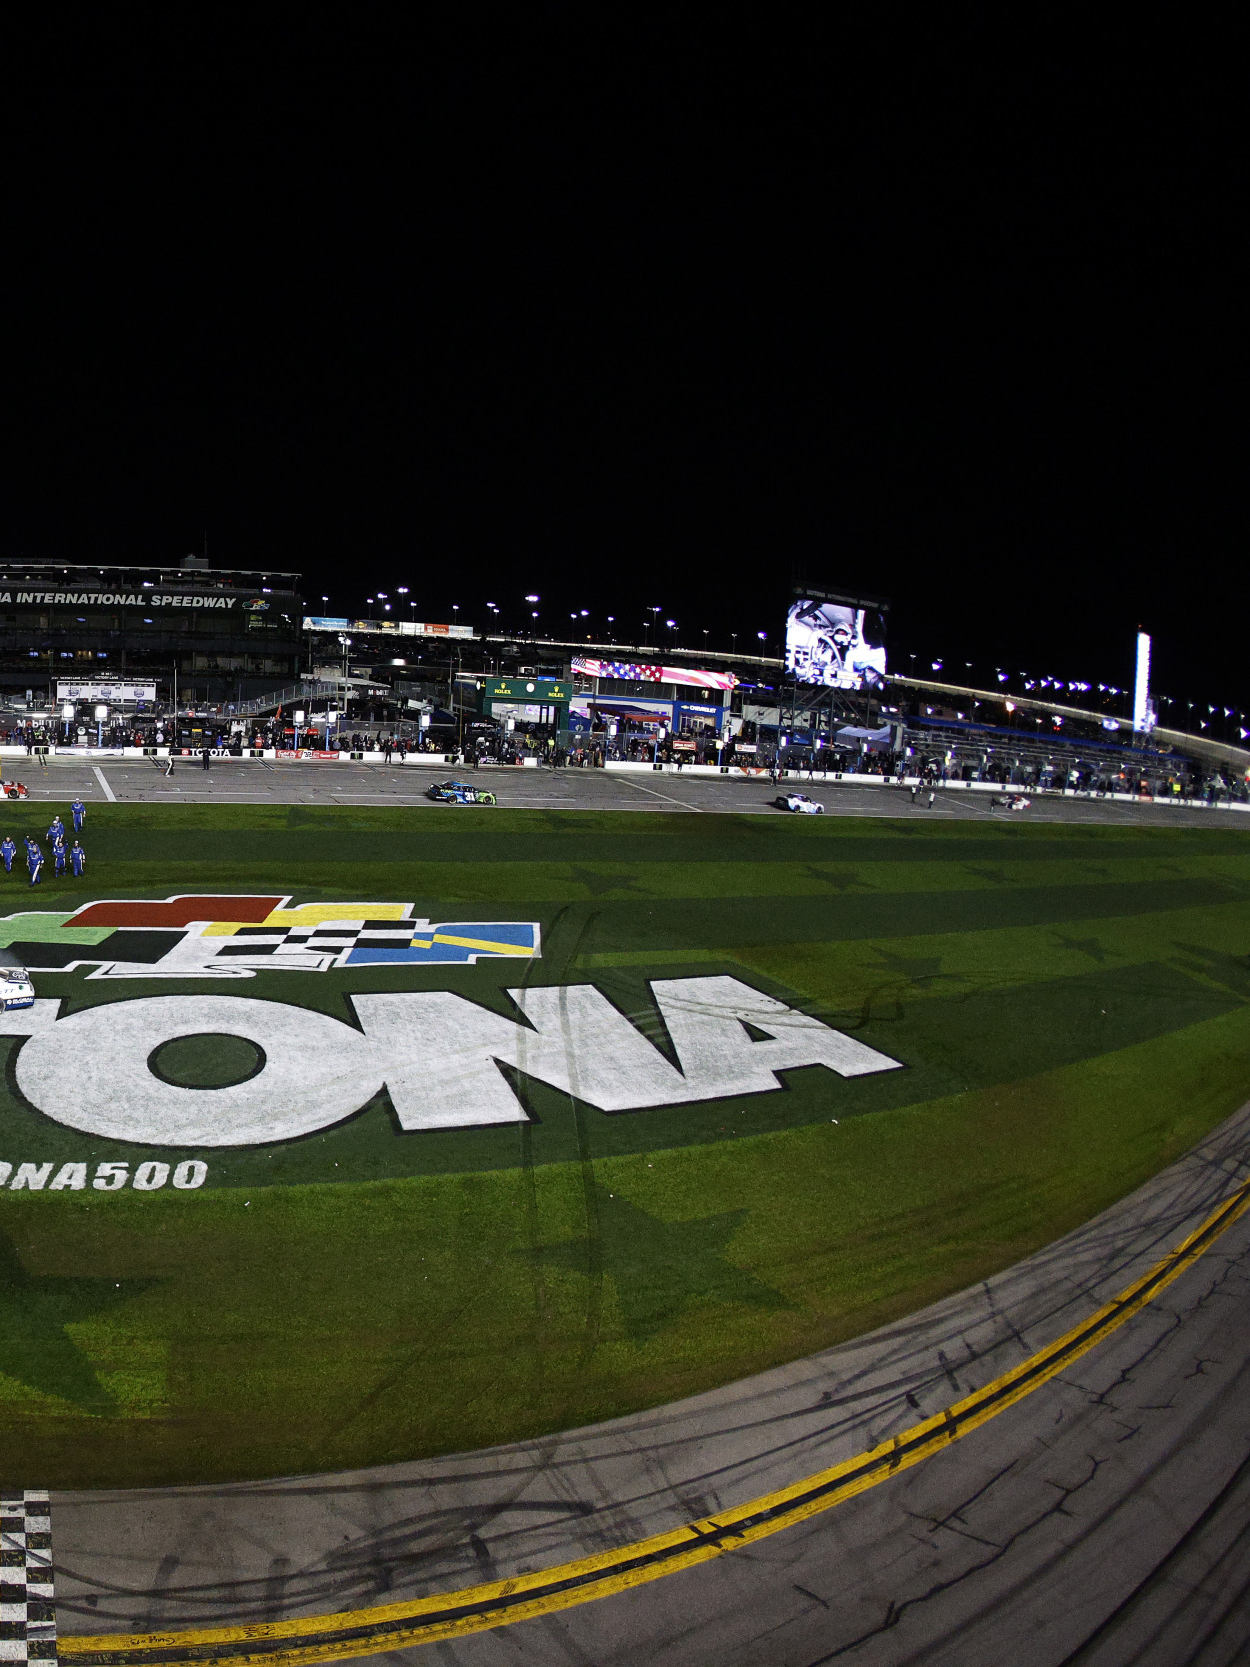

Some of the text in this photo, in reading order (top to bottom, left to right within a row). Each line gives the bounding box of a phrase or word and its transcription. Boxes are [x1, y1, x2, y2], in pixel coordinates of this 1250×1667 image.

[16, 592, 146, 606] INTERNATIONAL
[150, 595, 237, 609] SPEEDWAY
[689, 705, 717, 714] CHEVROLET
[465, 792, 475, 801] 31
